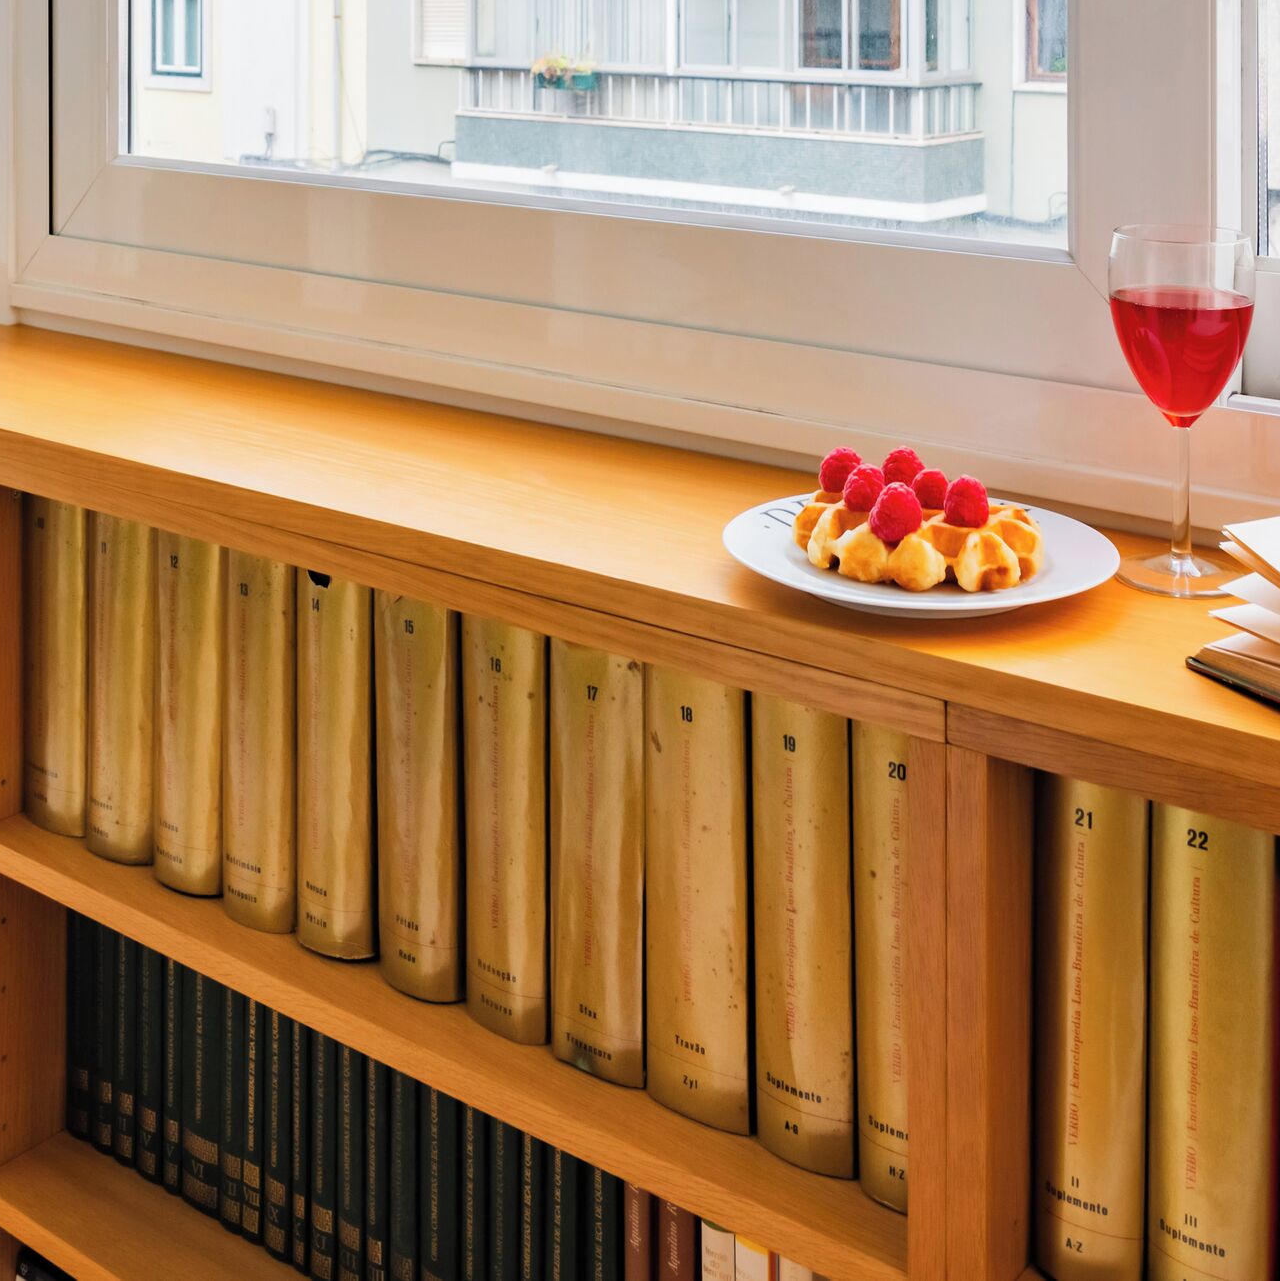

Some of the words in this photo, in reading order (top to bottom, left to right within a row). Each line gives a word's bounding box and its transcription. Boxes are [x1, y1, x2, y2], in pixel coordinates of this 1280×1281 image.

[311, 597, 321, 612] 14
[403, 618, 415, 635] 15
[489, 655, 502, 673] 16
[586, 684, 599, 701] 17
[679, 705, 693, 723] 18
[782, 733, 796, 753] 19
[888, 761, 907, 781] 20
[783, 766, 794, 809] Cultura
[784, 813, 794, 826] de
[890, 798, 901, 841] Cultura
[1074, 807, 1093, 830] 21
[1187, 828, 1209, 852] 22
[890, 846, 901, 859] de
[1073, 840, 1085, 888] Cultura
[1073, 893, 1084, 907] de
[1189, 876, 1201, 924] Cultura
[1189, 930, 1200, 944] de
[477, 958, 517, 983] Redenção
[889, 955, 903, 1031] Enciclopédia
[785, 1001, 795, 1041] VERBO
[674, 1033, 706, 1055] Travão
[1069, 1010, 1083, 1089] Enciclopédia
[891, 1043, 902, 1084] VERBO
[682, 1074, 698, 1090] Zyl
[766, 1070, 822, 1104] Suplemento
[1186, 1050, 1200, 1132] Enciclopédia
[1068, 1103, 1080, 1146] VERBO
[1185, 1146, 1197, 1191] VERBO
[1045, 1180, 1109, 1217] Suplemento
[1184, 1213, 1198, 1229] III
[1065, 1237, 1084, 1254] A-Z
[1159, 1217, 1226, 1259] Suplemento
